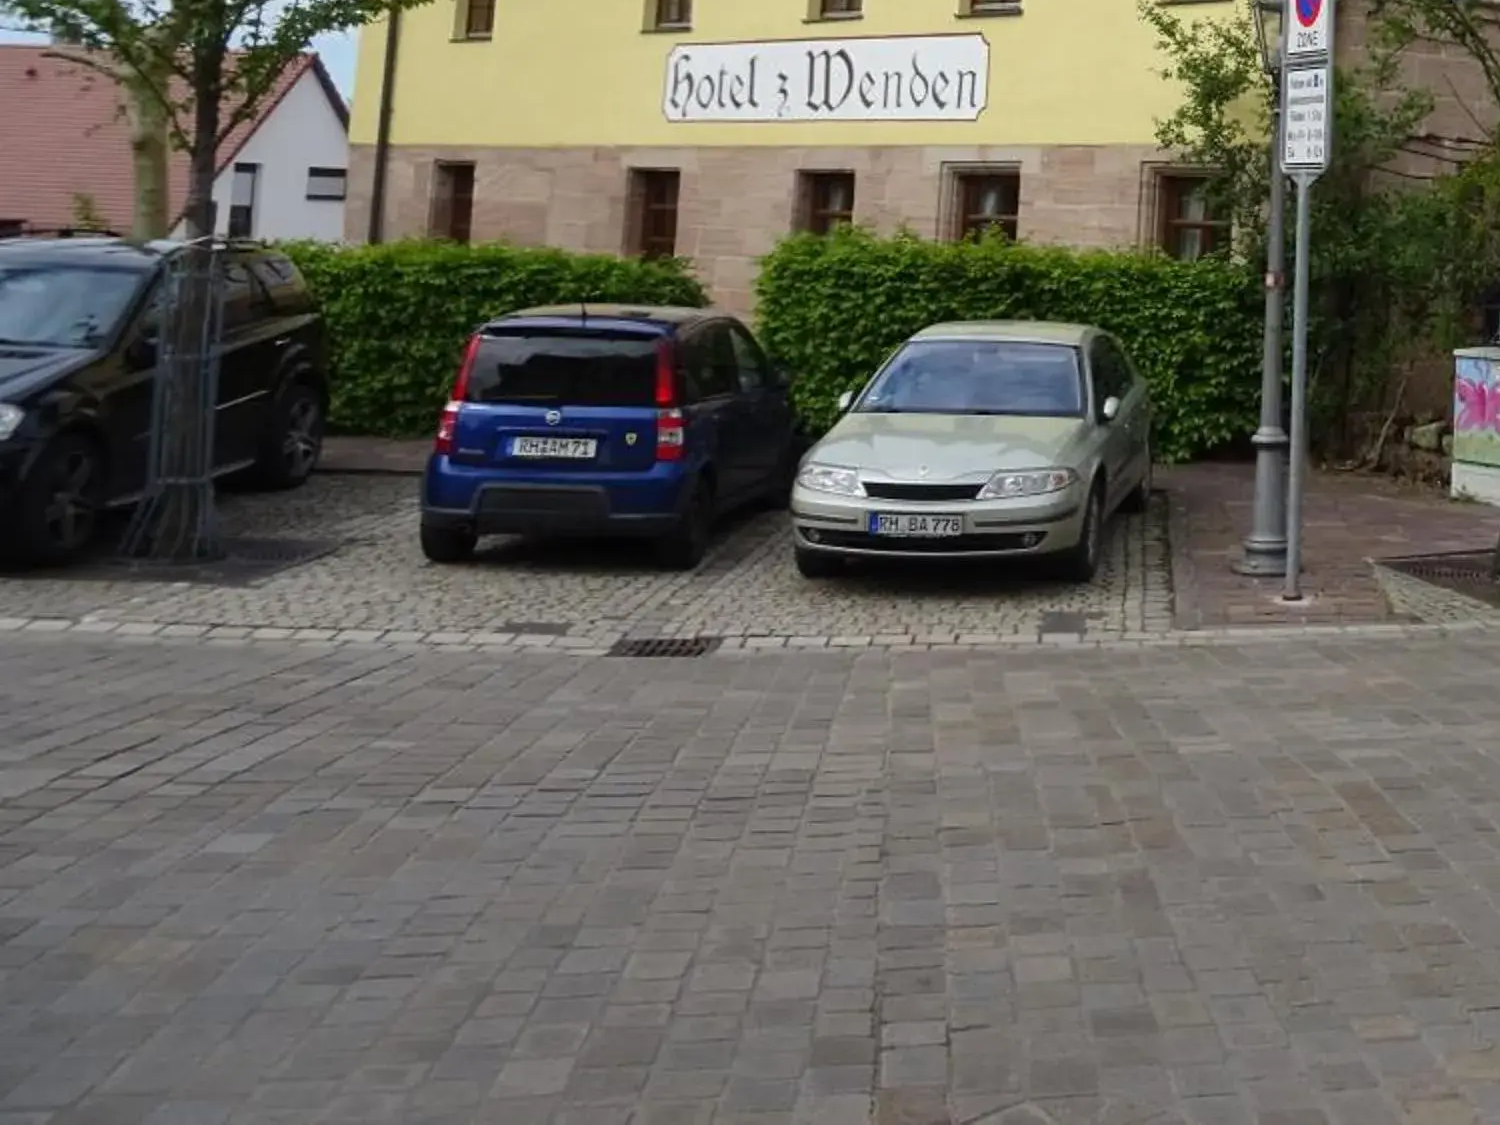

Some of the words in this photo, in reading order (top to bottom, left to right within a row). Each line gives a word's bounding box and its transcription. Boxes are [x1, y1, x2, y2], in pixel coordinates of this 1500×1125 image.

[1296, 30, 1319, 48] ZONE
[669, 53, 758, 117] Hotel
[805, 48, 977, 112] Wenden
[879, 516, 899, 532] RH
[909, 516, 928, 532] BA
[932, 518, 961, 532] 778
